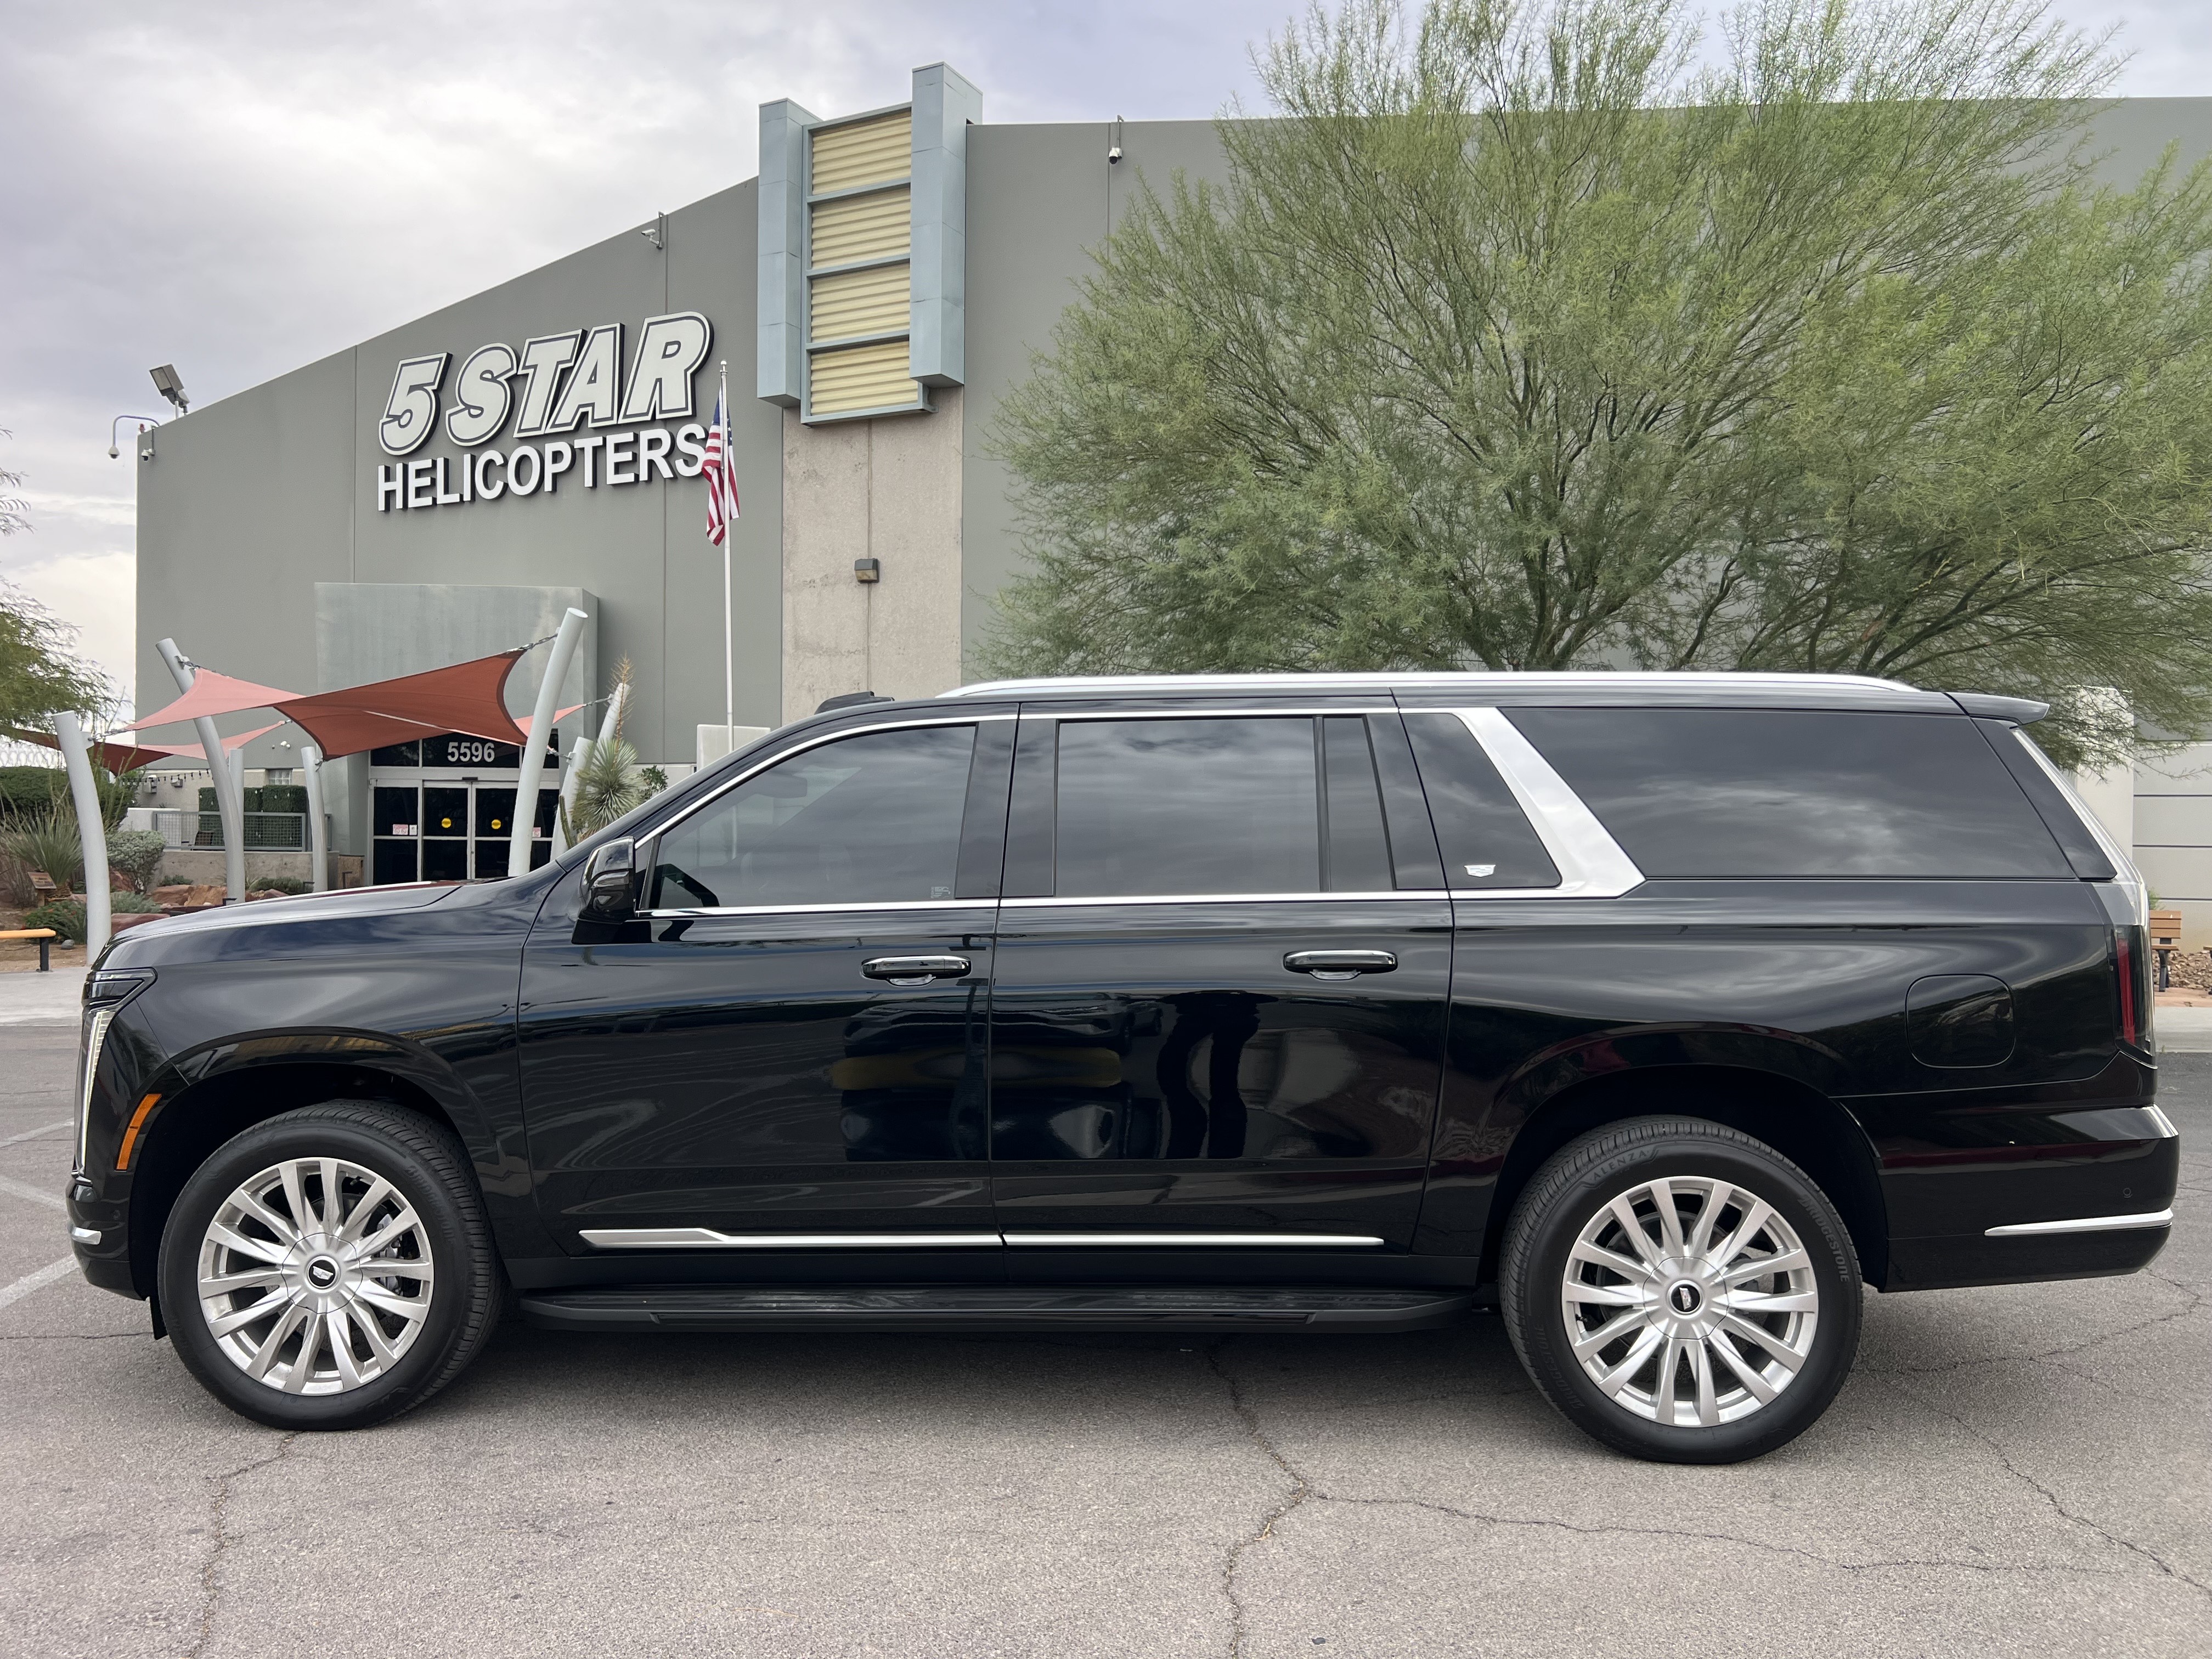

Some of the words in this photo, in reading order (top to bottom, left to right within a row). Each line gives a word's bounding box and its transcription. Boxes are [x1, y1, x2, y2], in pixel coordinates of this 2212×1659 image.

[378, 352, 453, 456] 5
[445, 311, 714, 447] STAR
[377, 423, 709, 512] HELICOPTERS
[447, 742, 494, 763] 5596
[1593, 1150, 1646, 1181] ALENZA
[1797, 1195, 1849, 1283] BRIDGESTONE
